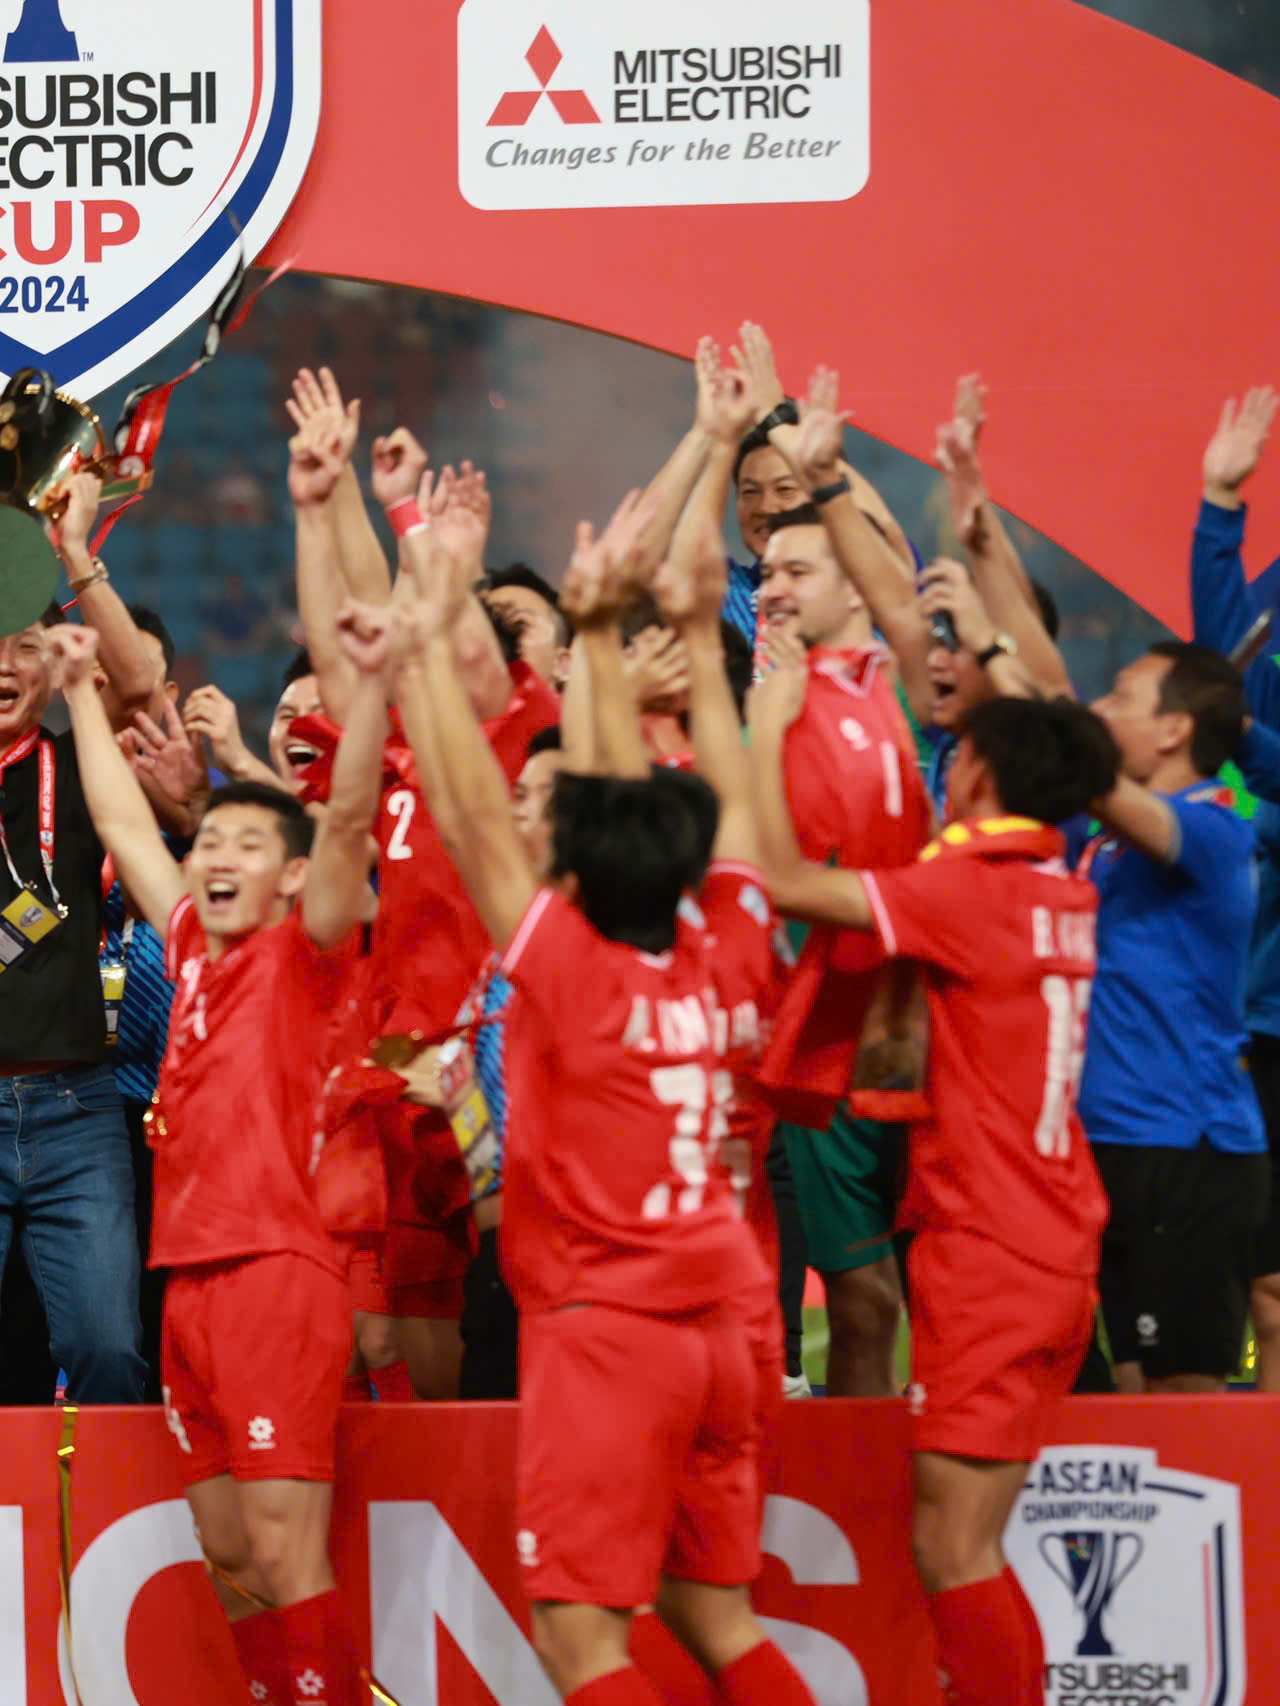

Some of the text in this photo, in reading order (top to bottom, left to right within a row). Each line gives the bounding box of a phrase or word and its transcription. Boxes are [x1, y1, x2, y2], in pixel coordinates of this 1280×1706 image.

[614, 44, 841, 84] MITSUBISHI
[614, 83, 811, 123] ELECTRIC
[485, 132, 841, 169] Changes for the Better
[387, 789, 416, 860] 2
[1040, 1461, 1138, 1494] ASEAN
[1022, 1500, 1160, 1524] CHAMPIONSHIP
[1045, 1662, 1190, 1691] TSUBISHI
